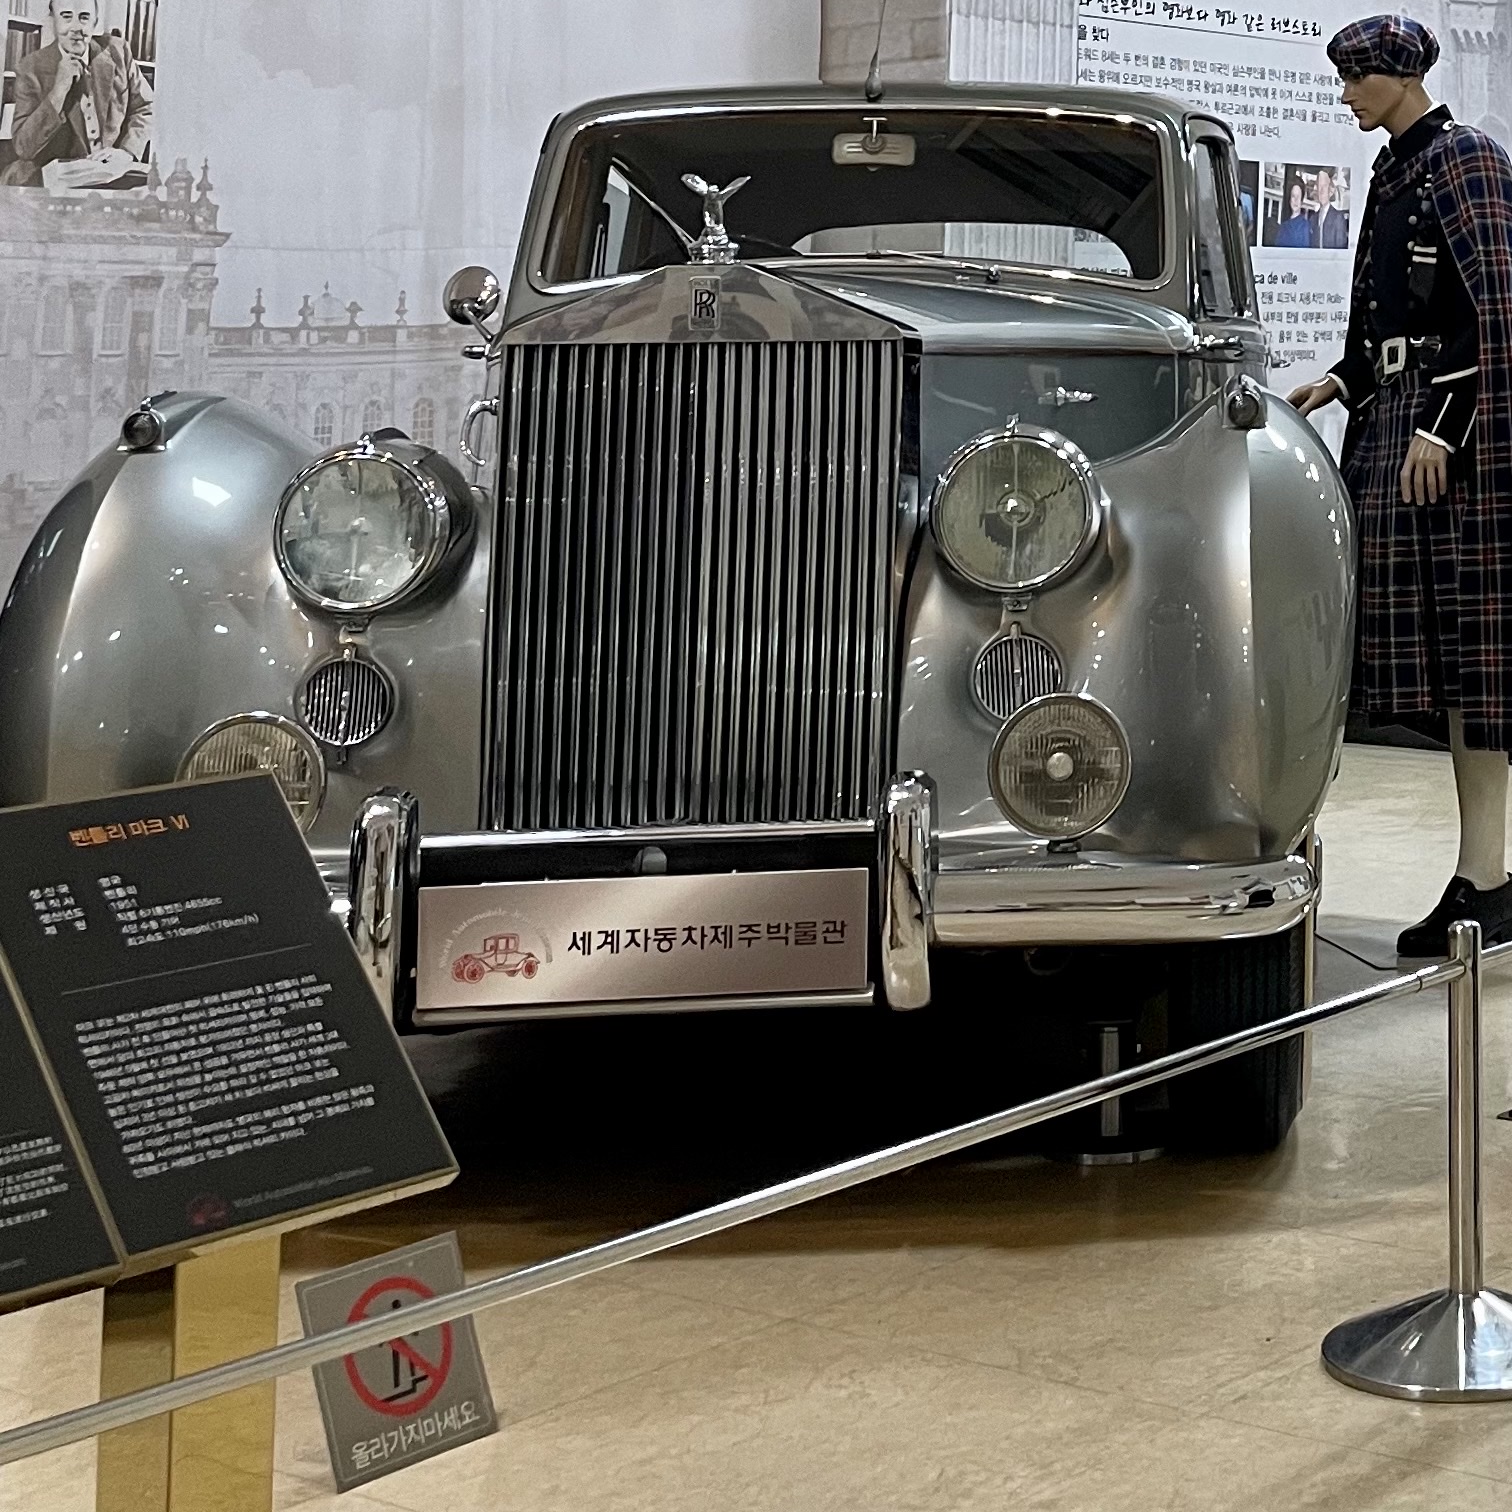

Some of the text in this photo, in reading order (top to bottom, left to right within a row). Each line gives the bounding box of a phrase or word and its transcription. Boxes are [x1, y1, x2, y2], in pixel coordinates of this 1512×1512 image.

[1242, 13, 1265, 33] 같은
[1270, 17, 1322, 37] 러브스토리
[1122, 52, 1131, 65] 두
[1295, 90, 1313, 103] 스스로
[1267, 272, 1279, 285] de
[128, 818, 168, 835] 마크
[567, 919, 848, 957] 세계자동차제주박물관
[351, 1400, 481, 1470] 올라가지마세요
